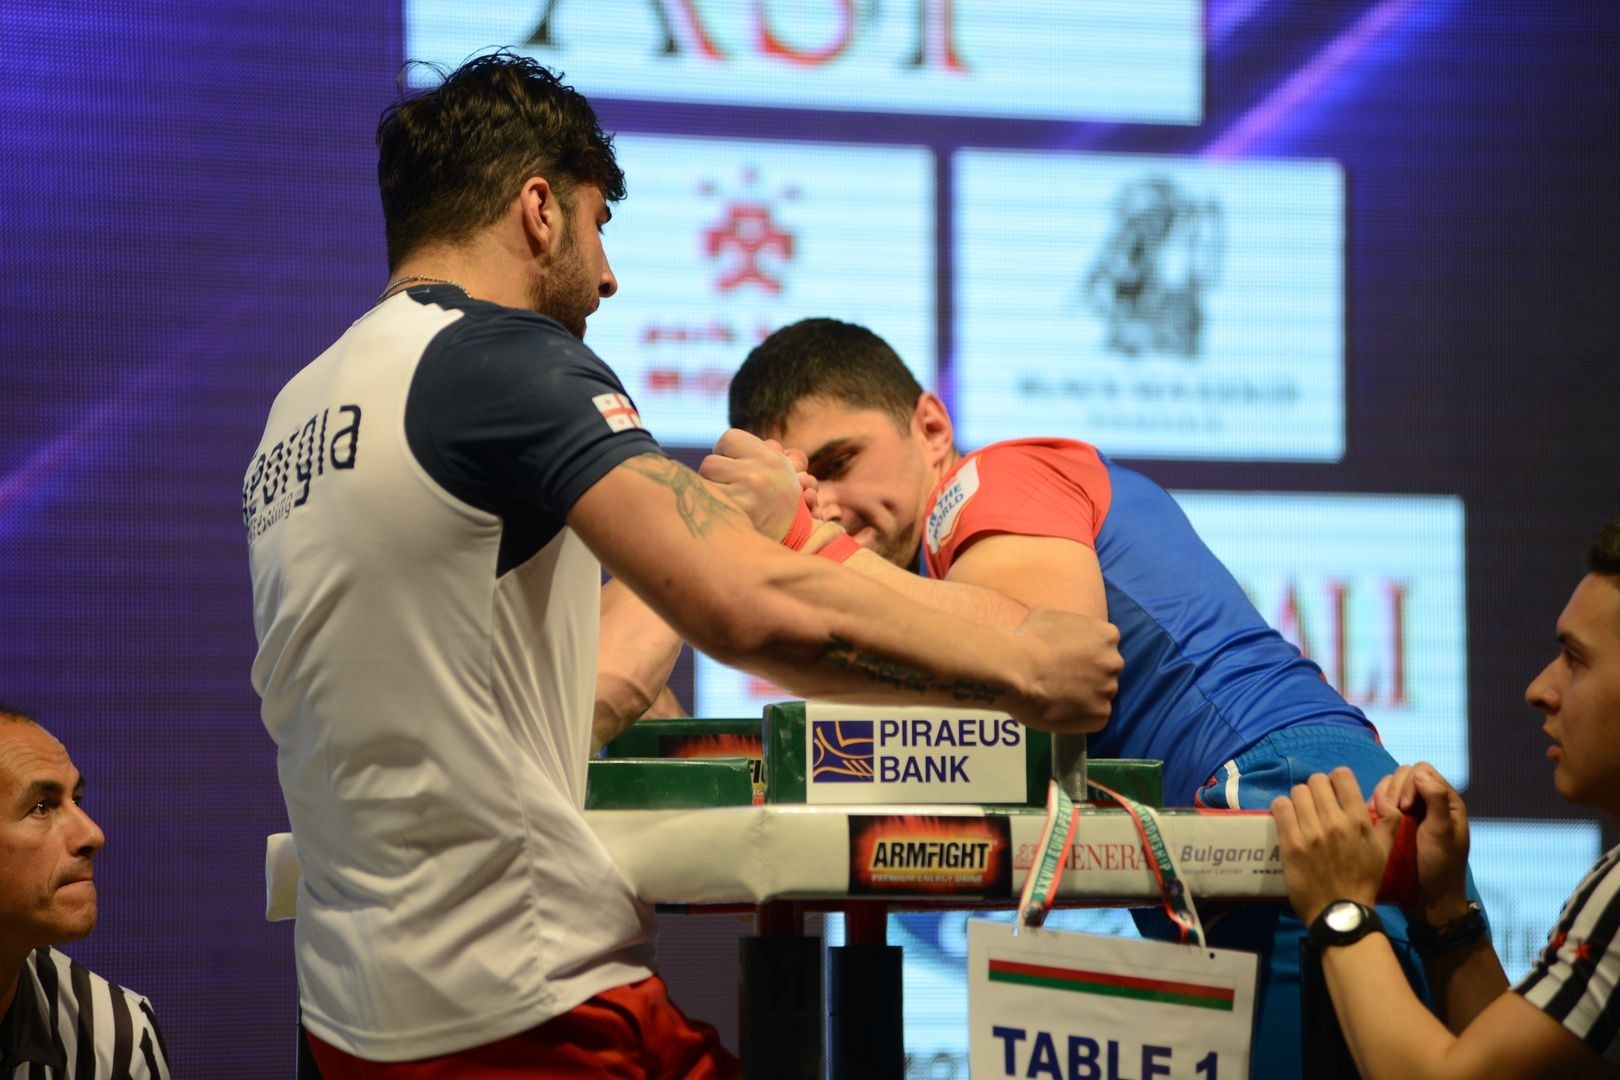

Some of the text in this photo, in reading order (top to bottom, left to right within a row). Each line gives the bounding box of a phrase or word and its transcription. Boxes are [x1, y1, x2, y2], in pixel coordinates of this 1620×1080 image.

[937, 482, 962, 509] THE
[933, 493, 964, 539] WORLD
[879, 719, 1021, 747] PIRAEUS
[879, 755, 971, 783] BANK
[872, 842, 990, 869] ARMFIGHT
[1064, 844, 1156, 871] ENERA
[1181, 845, 1265, 866] Bulgaria
[992, 1025, 1173, 1080] TABLE
[1195, 1051, 1219, 1080] 1
